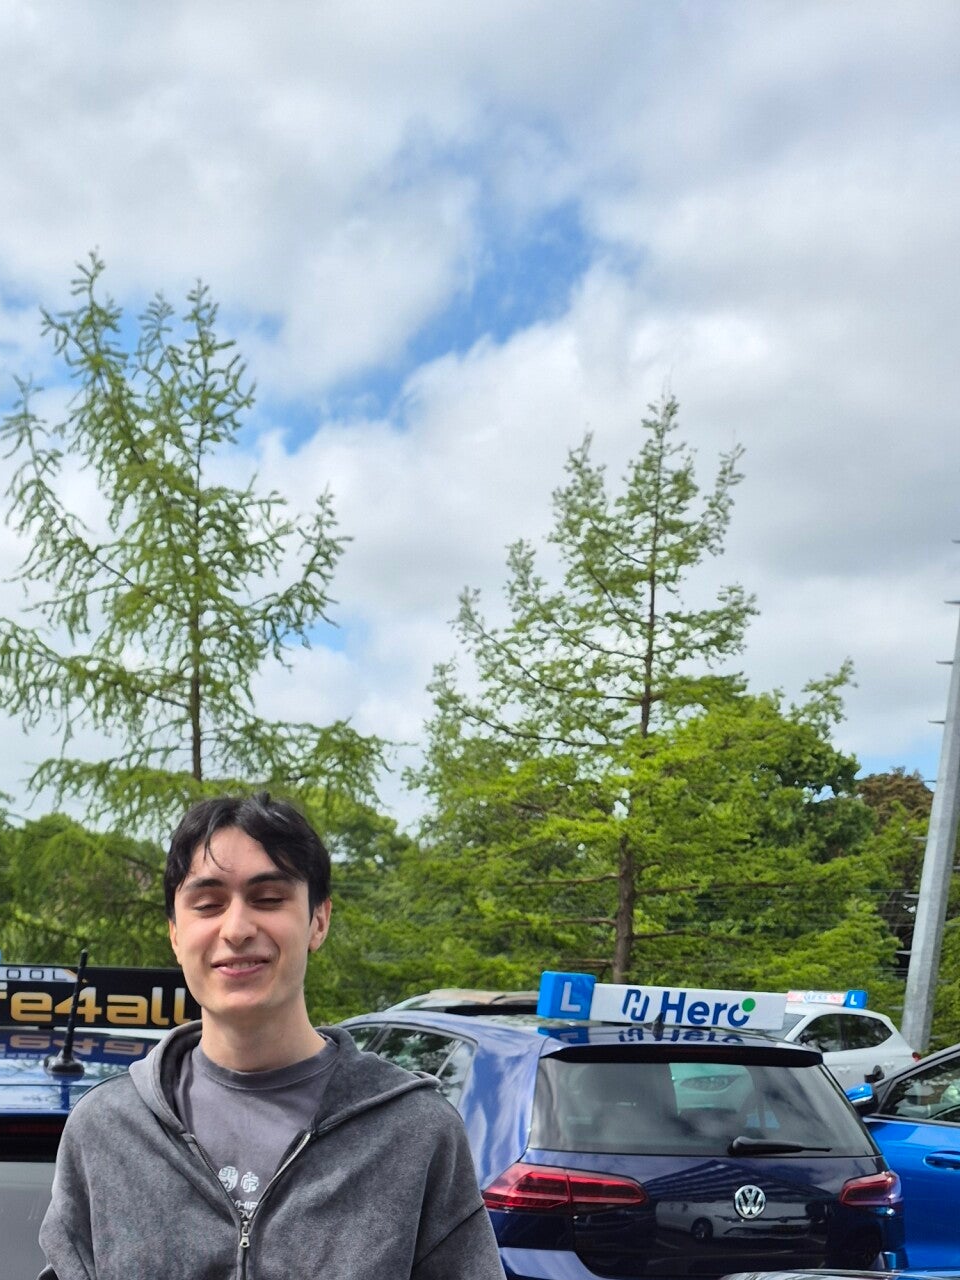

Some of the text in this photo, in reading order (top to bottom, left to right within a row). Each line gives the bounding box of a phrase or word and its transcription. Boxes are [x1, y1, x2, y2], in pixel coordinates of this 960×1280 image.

[560, 981, 581, 1013] L
[661, 990, 756, 1027] Hero
[850, 993, 858, 1006] L
